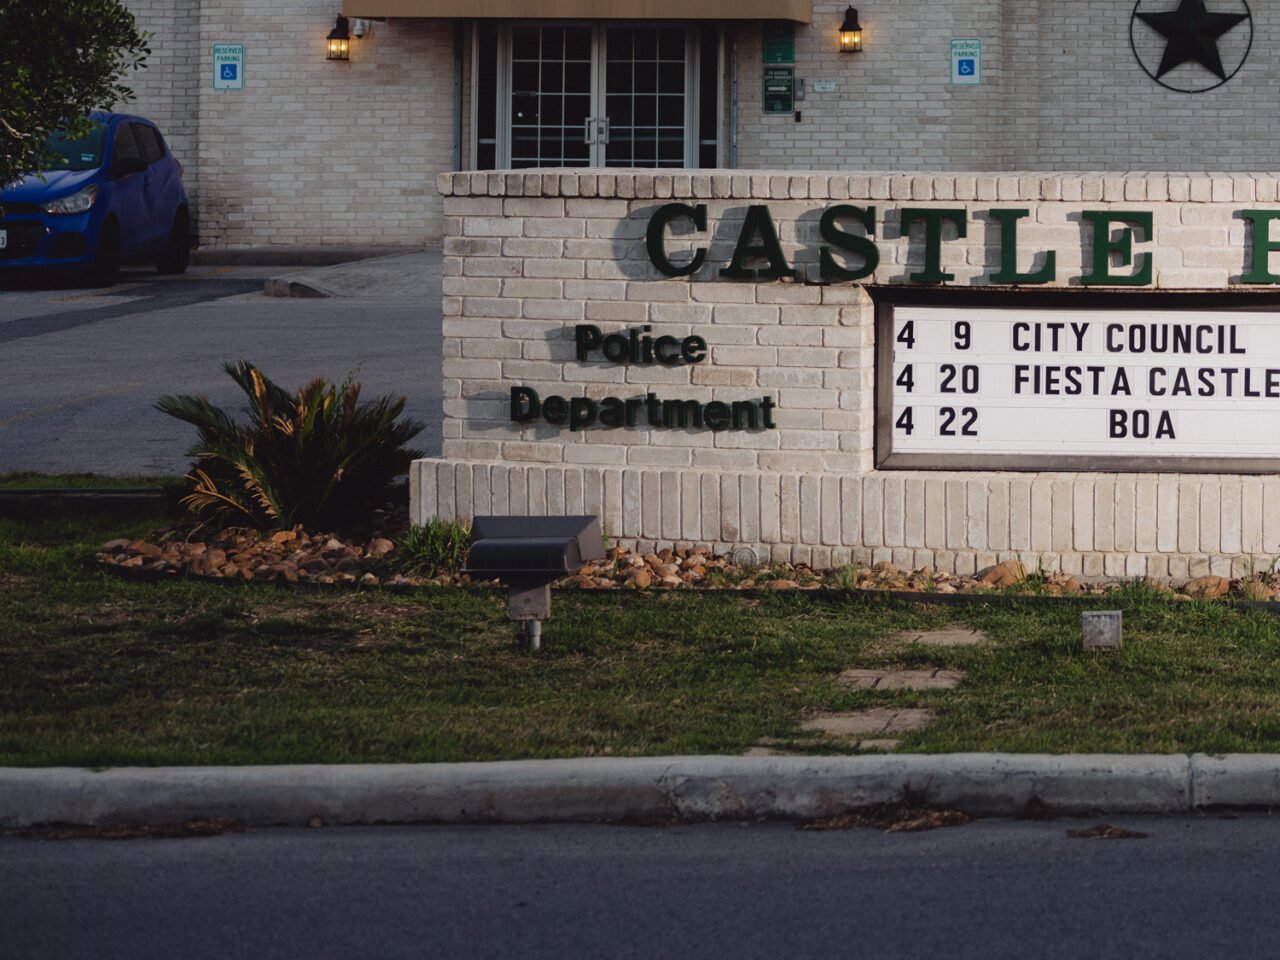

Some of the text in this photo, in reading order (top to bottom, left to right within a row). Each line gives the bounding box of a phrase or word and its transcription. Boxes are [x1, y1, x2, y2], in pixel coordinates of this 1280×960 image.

[645, 202, 1153, 286] CASTLE
[575, 324, 707, 365] Police
[896, 320, 916, 349] 4
[954, 321, 971, 350] 9
[1012, 322, 1090, 352] CITY
[1106, 323, 1246, 355] COUNCIL
[896, 364, 914, 392] 4
[939, 364, 979, 394] 20
[1014, 365, 1132, 396] FIESTA
[1149, 367, 1280, 398] CASTLE
[510, 386, 776, 432] Department
[895, 406, 914, 436] 4
[939, 407, 978, 436] 22
[1109, 409, 1176, 439] BOA
